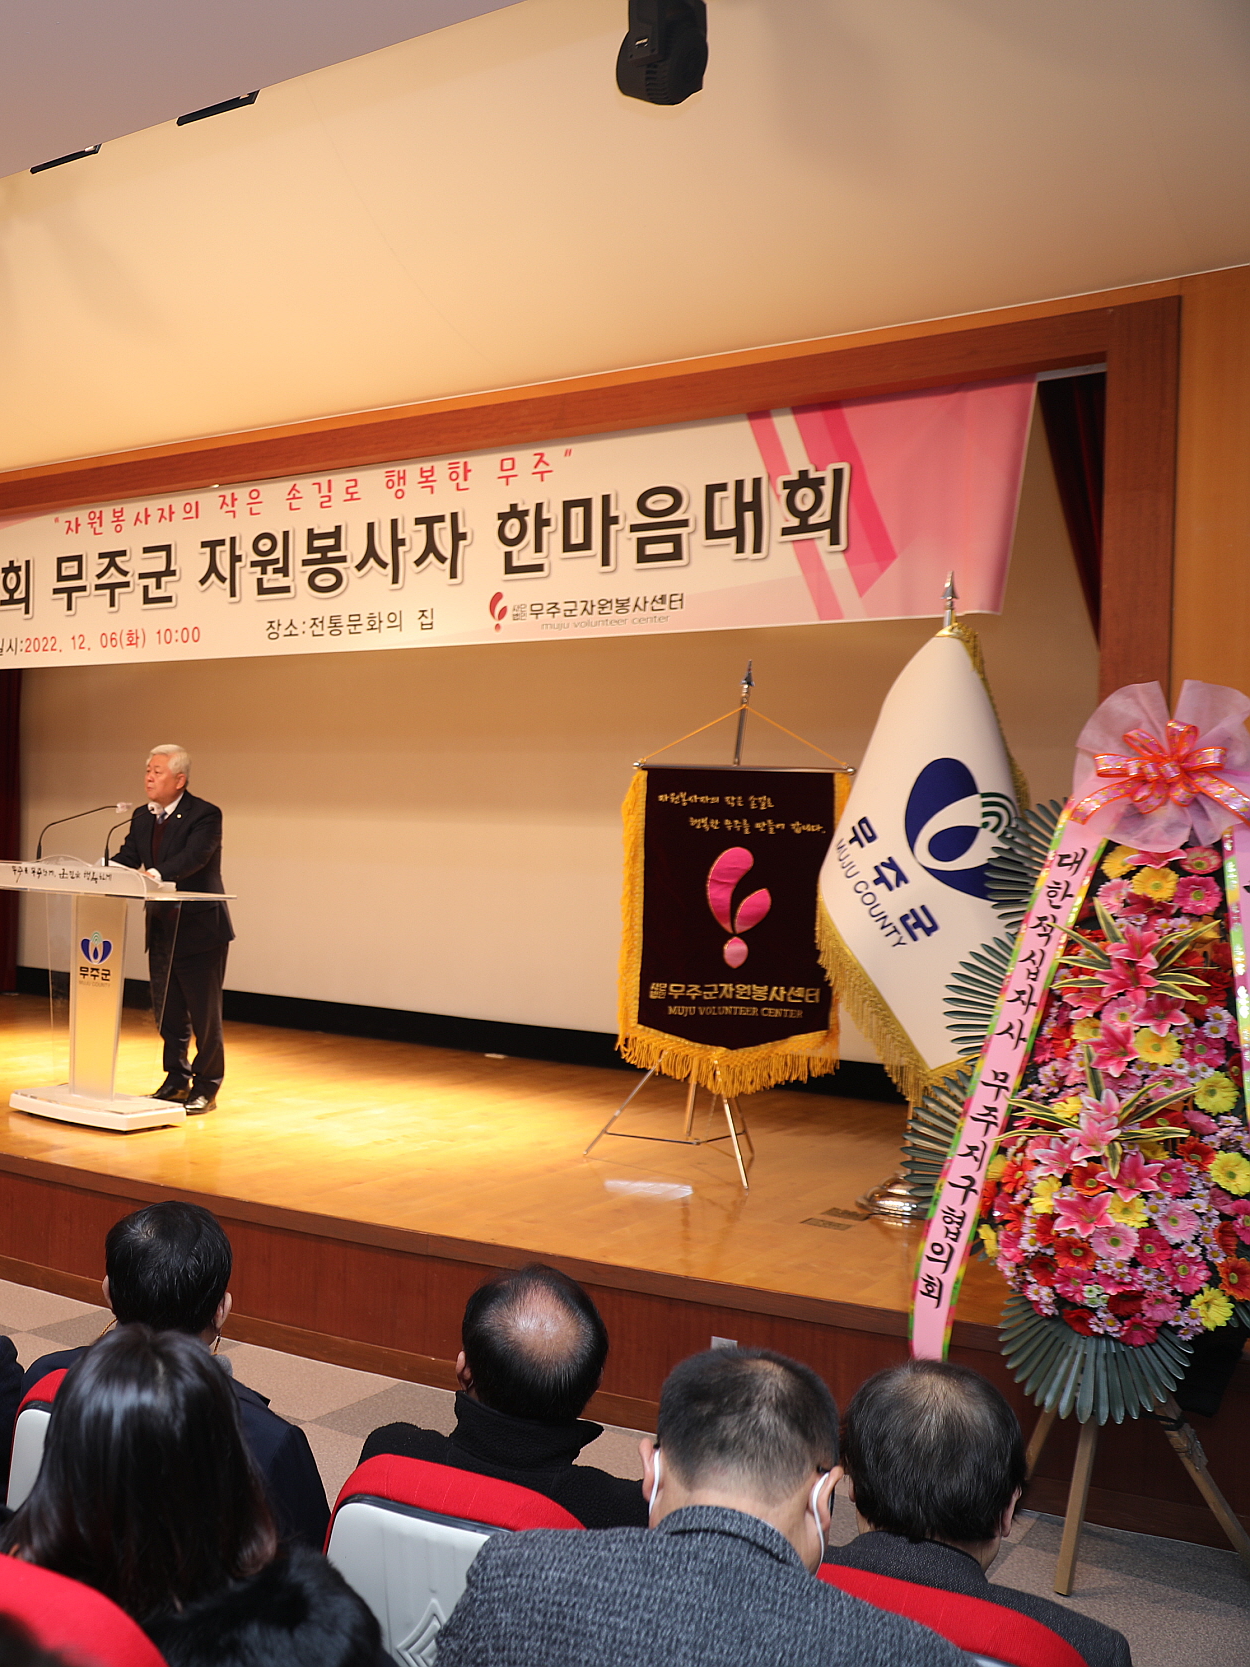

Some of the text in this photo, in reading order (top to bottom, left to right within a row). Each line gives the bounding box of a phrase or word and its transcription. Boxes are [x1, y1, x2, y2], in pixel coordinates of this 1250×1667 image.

[218, 488, 264, 519] 작은
[286, 478, 361, 512] 손길로
[384, 460, 472, 500] 행복한
[52, 543, 177, 612] 무주군
[198, 511, 468, 598] 자원봉사자
[496, 466, 845, 575] 한마음대회
[529, 592, 685, 620] 무주군자원봉사센터
[417, 608, 434, 631] 집
[541, 614, 670, 631] muju volunteer center
[100, 628, 146, 649] 06(화)
[156, 626, 201, 645] 10:00
[848, 816, 941, 942] 무주군
[853, 880, 908, 948] COUNTY
[79, 966, 111, 982] 무주군
[668, 983, 821, 1003] 무주군자원봉사센터
[668, 1005, 803, 1019] MUJU VOLUNTEER CENTER
[919, 847, 1087, 1309] 대한적십자사 무주지구협의회
